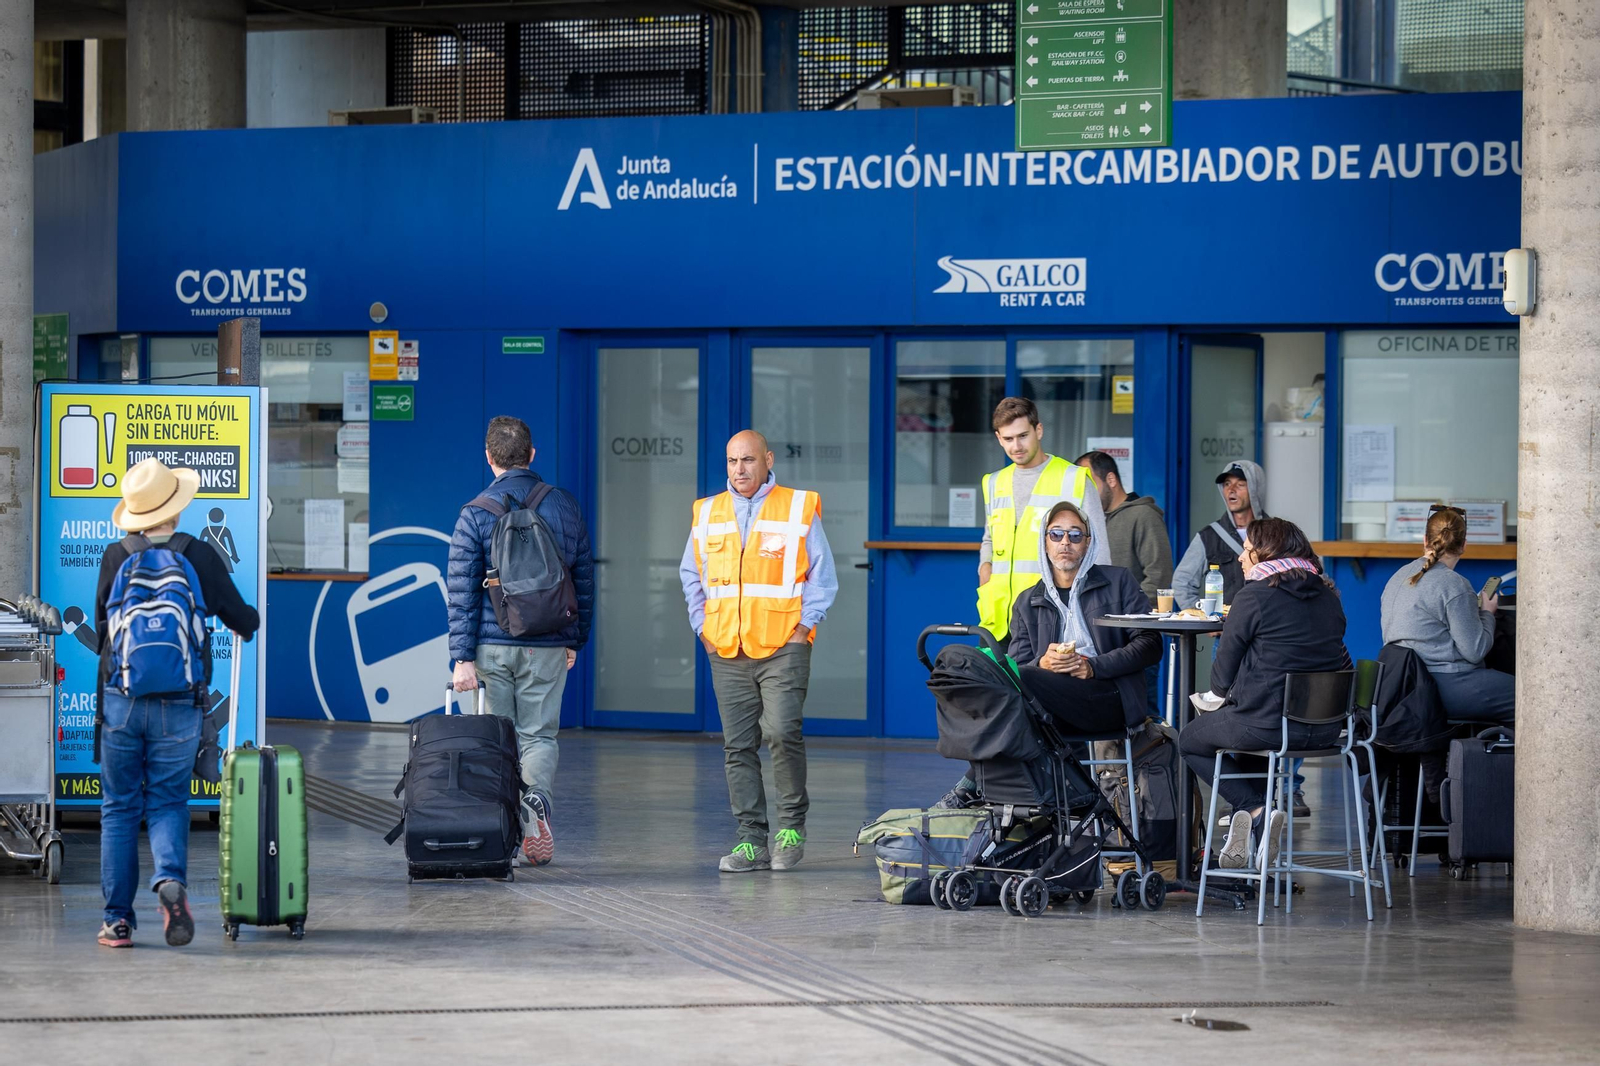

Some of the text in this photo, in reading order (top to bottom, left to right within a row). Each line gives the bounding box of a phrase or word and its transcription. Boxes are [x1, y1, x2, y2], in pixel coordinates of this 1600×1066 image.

[1048, 51, 1077, 59] ESTACIÓN
[616, 155, 671, 175] Junta
[775, 143, 1300, 191] ESTACIÓN-INTERCAMBIADOR
[1311, 145, 1361, 180] DE
[616, 175, 737, 200] de Andalucía
[996, 264, 1080, 287] GALCO
[175, 267, 308, 304] COMES
[1000, 293, 1085, 307] RENT A CAR
[1394, 297, 1504, 306] TRANSPORTES GENER
[191, 308, 245, 316] TRANSPORTES
[266, 342, 332, 357] BILLETES
[1378, 336, 1460, 352] OFICINA
[1465, 336, 1490, 351] DE
[126, 401, 239, 422] CARGA TU MÓVIL
[126, 423, 219, 441] SIN ENCHUFE:
[611, 437, 683, 456] COMES
[1201, 437, 1244, 457] COMES
[157, 451, 235, 466] PRE-CHARGED
[60, 545, 104, 554] SOLO PARA
[60, 556, 94, 567] TAMBIÉN
[61, 776, 100, 795] Y MÁS
